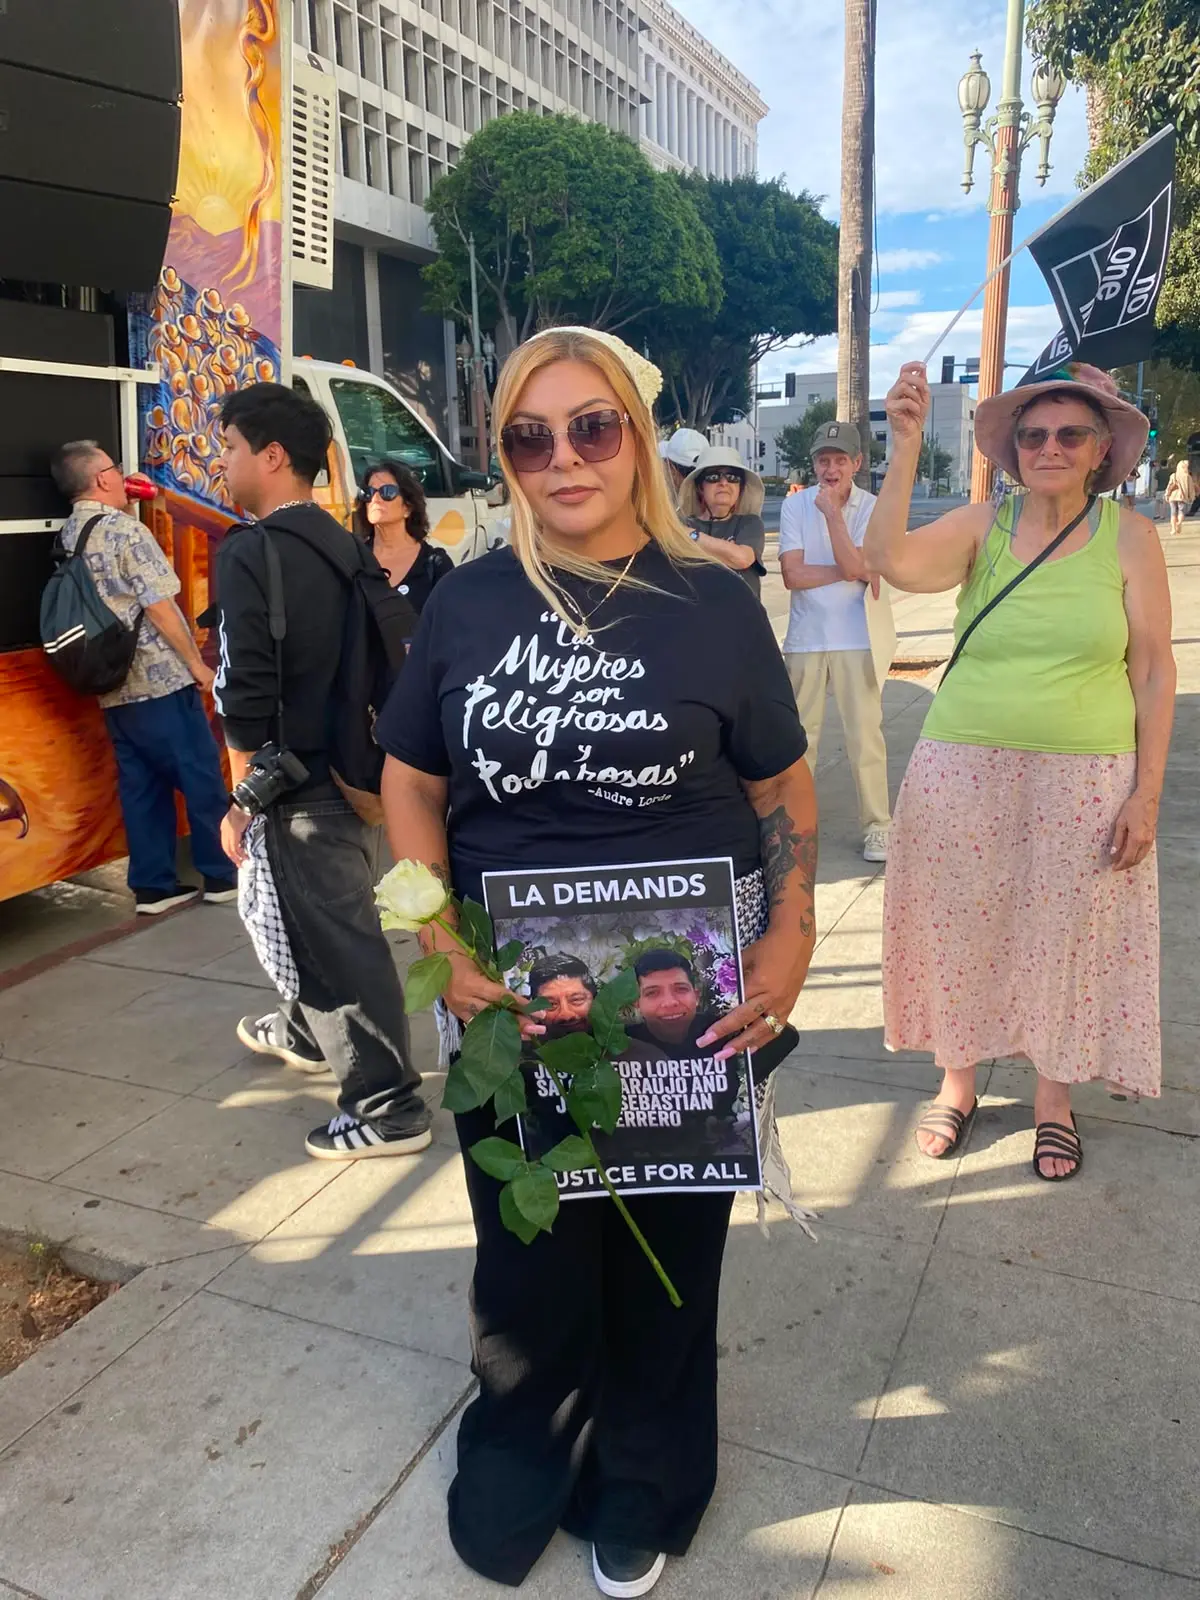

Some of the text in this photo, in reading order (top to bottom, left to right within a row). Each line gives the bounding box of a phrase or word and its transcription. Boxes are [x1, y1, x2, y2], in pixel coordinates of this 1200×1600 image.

[1096, 246, 1137, 301] one
[1127, 272, 1157, 314] no
[490, 633, 646, 694] Mujeres
[568, 687, 624, 706] son
[463, 675, 669, 749] Peligrosas
[573, 744, 592, 763] y
[508, 873, 707, 907] LA DEMANDS
[646, 1057, 727, 1078] LORENZO
[620, 1074, 728, 1094] ARAUJO AND
[620, 1093, 713, 1111] SEBASTIAN
[553, 1162, 748, 1188] USTCE FOR ALL
